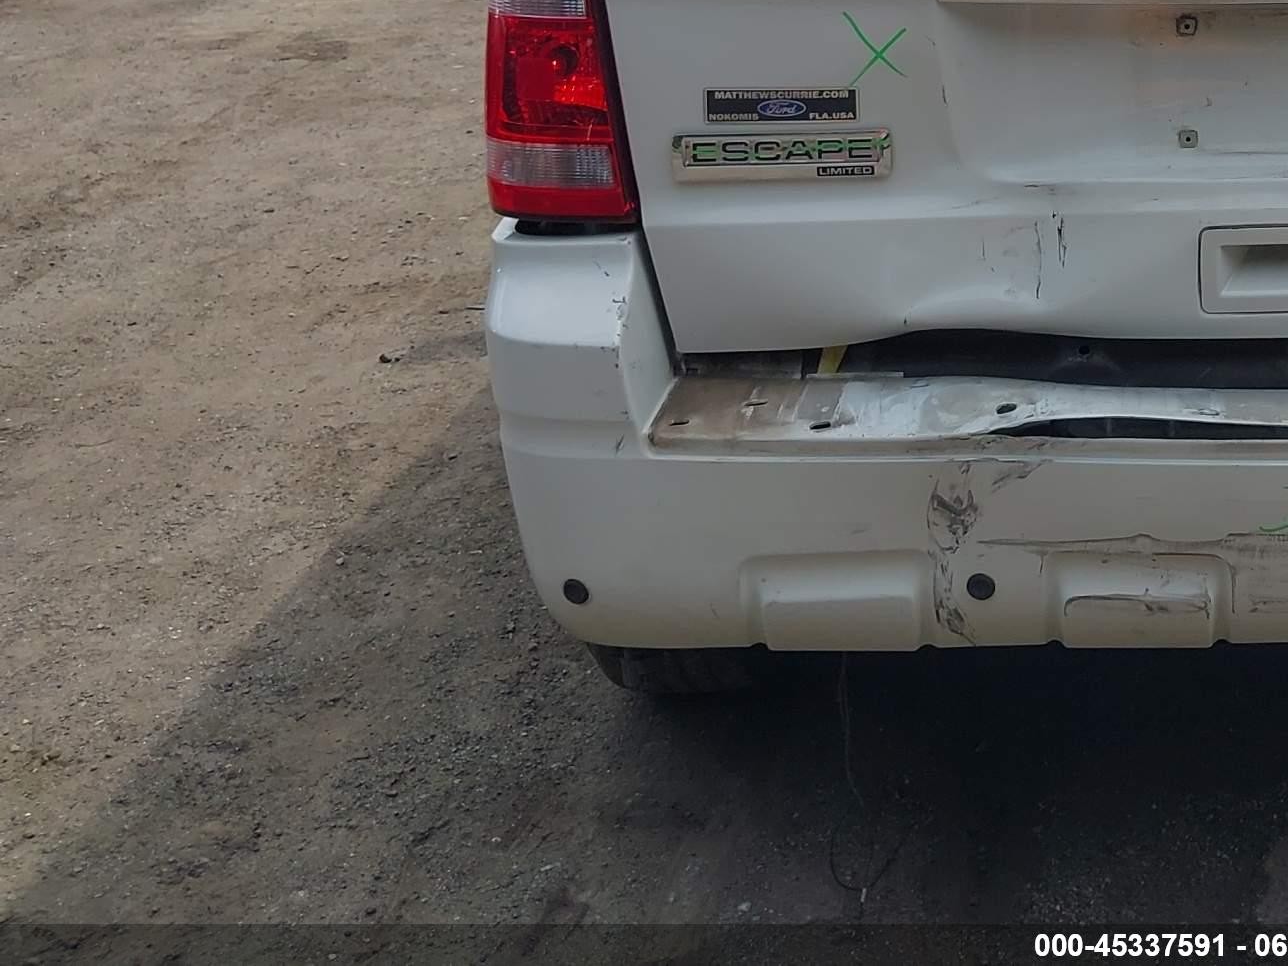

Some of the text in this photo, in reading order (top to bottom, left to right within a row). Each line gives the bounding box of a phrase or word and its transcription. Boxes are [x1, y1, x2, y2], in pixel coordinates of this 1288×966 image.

[714, 90, 849, 100] MATTHEWSCURRIE.COM
[766, 101, 797, 114] Ford
[708, 113, 760, 122] NOKOMIS
[692, 138, 873, 163] ESCAPE
[818, 166, 873, 176] LIMITED
